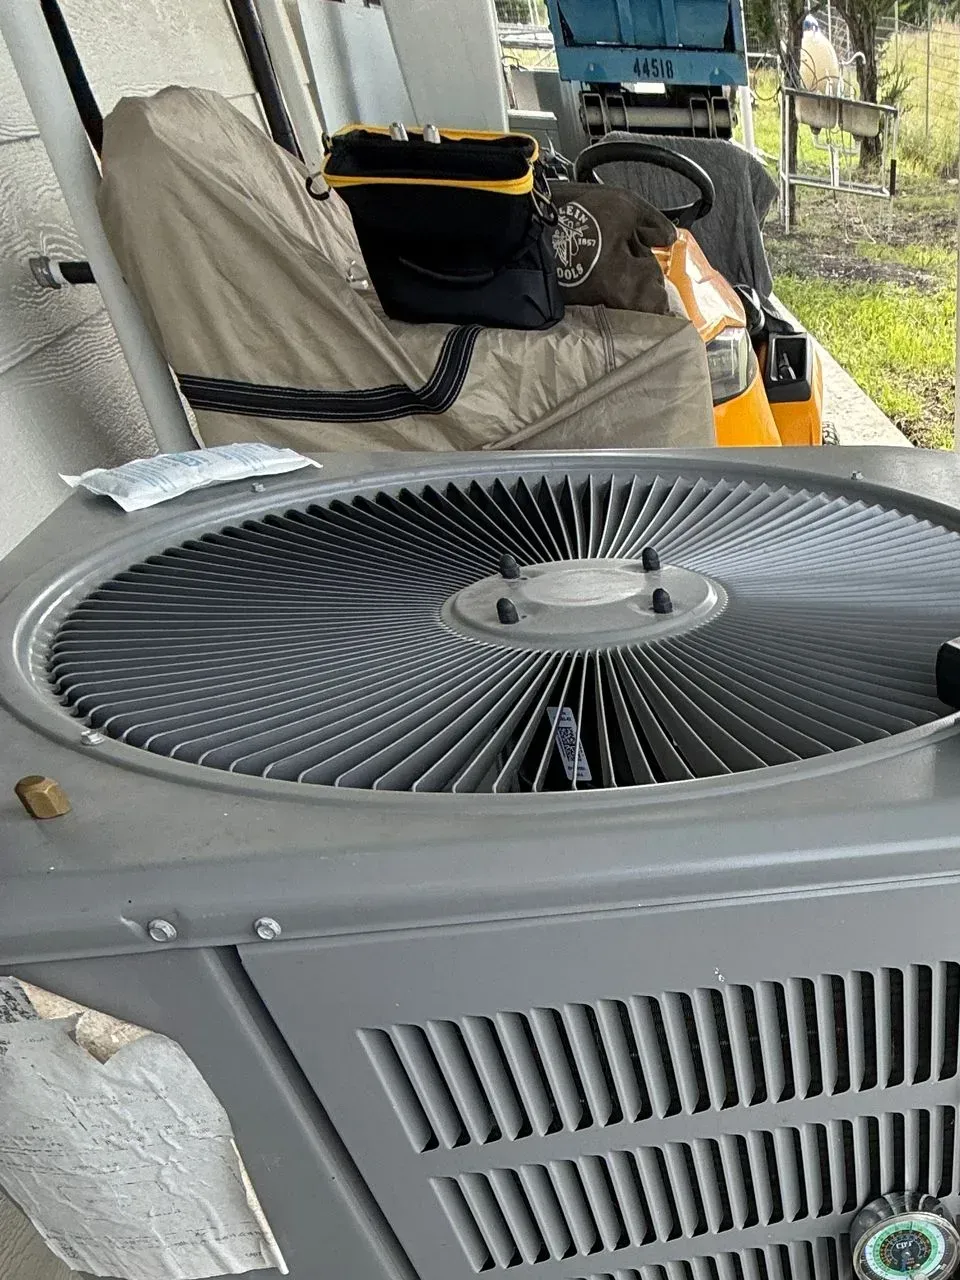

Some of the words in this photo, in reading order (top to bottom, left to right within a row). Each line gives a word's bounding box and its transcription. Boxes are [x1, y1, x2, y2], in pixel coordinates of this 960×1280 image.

[633, 57, 674, 79] 44518
[558, 205, 588, 224] LEIN
[578, 238, 596, 247] 1857
[556, 263, 584, 280] OOLS
